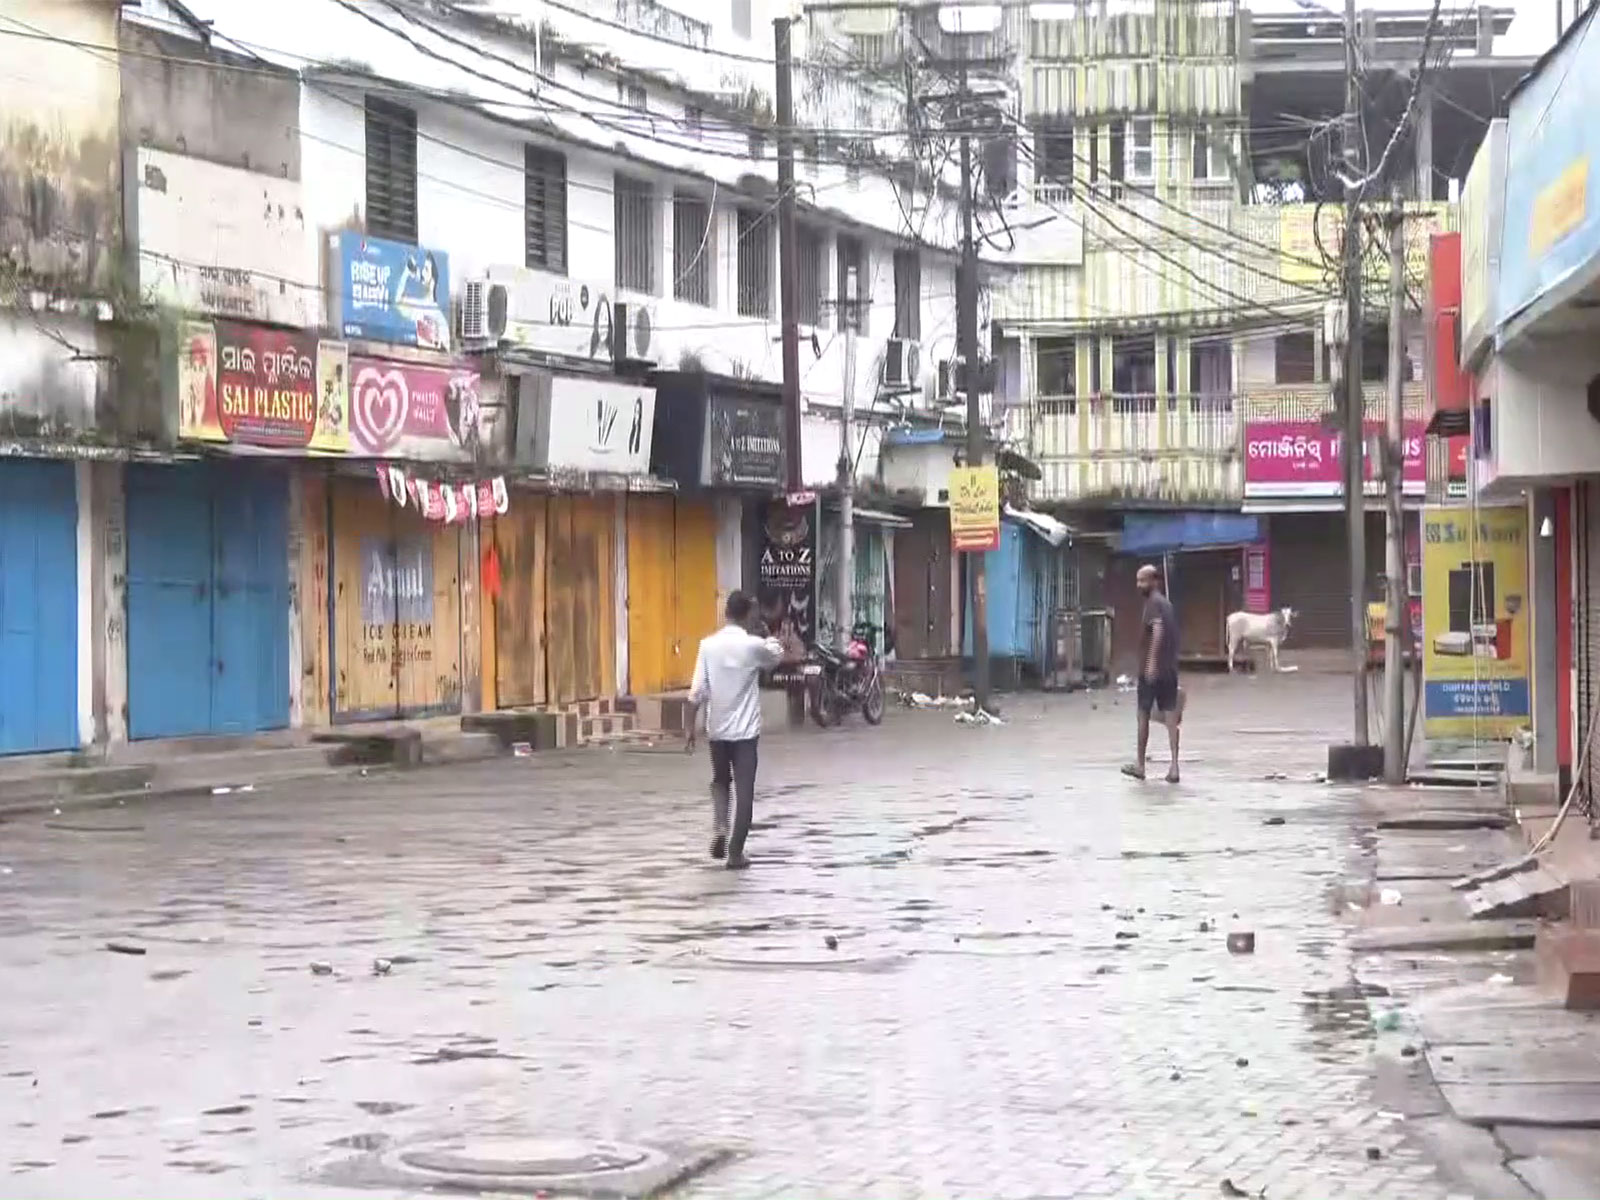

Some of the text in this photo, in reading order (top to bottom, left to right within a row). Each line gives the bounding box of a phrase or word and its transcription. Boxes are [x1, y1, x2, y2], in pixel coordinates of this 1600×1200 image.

[222, 383, 313, 423] SAI PLASTIC
[761, 548, 774, 564] A
[799, 548, 812, 564] Z
[761, 564, 811, 576] IMITATIONS
[363, 622, 384, 641] ICE
